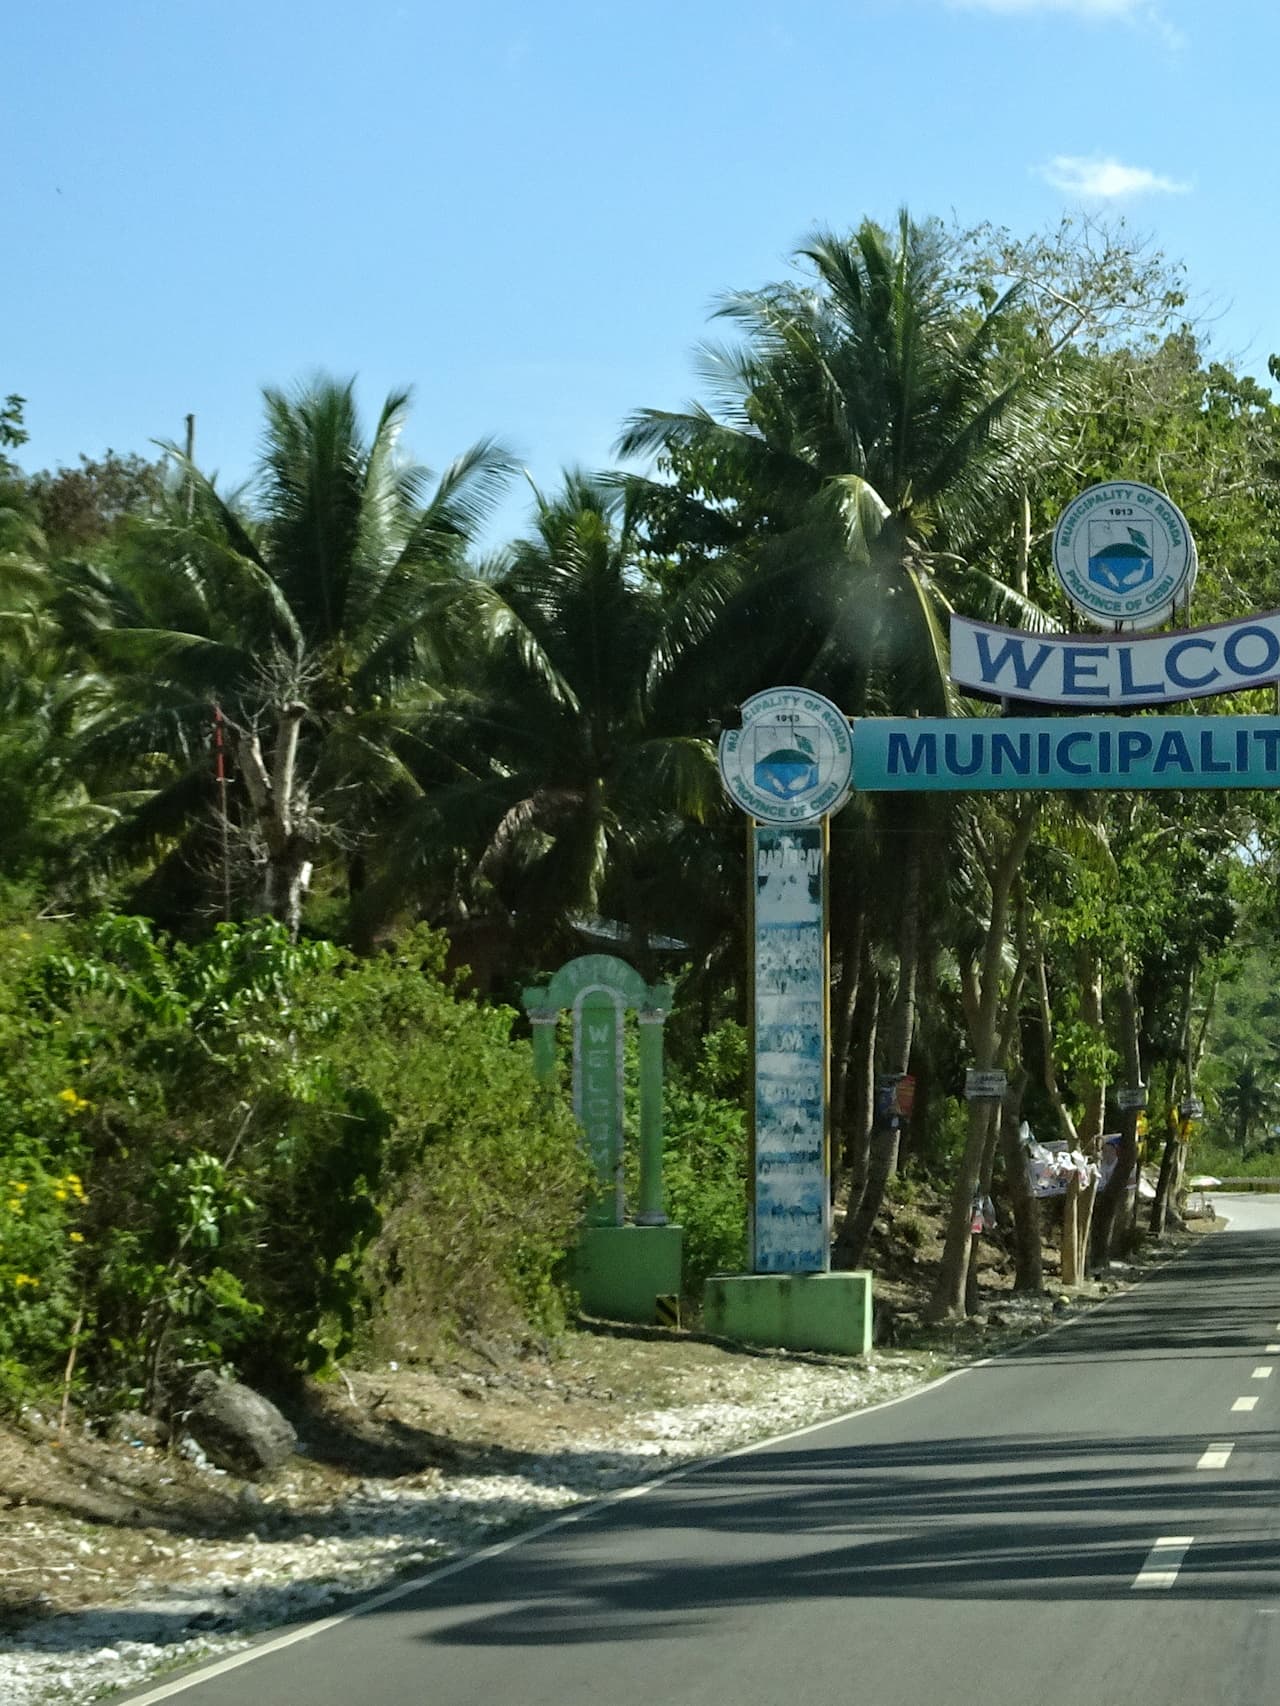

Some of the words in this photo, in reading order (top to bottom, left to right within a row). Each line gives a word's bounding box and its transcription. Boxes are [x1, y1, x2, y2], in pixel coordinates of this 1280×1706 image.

[1060, 489, 1134, 547] MUNICIPALITY
[1137, 493, 1154, 506] OF
[1154, 503, 1182, 548] RONDA
[1065, 569, 1122, 612] PROVINCE
[1125, 599, 1142, 611] OF
[1145, 575, 1174, 604] CEBU
[727, 695, 801, 753] MUCIPALITY
[804, 699, 822, 712] OF
[821, 710, 847, 754] RONDA
[732, 775, 787, 817] PROVINCE
[790, 804, 808, 817] OF
